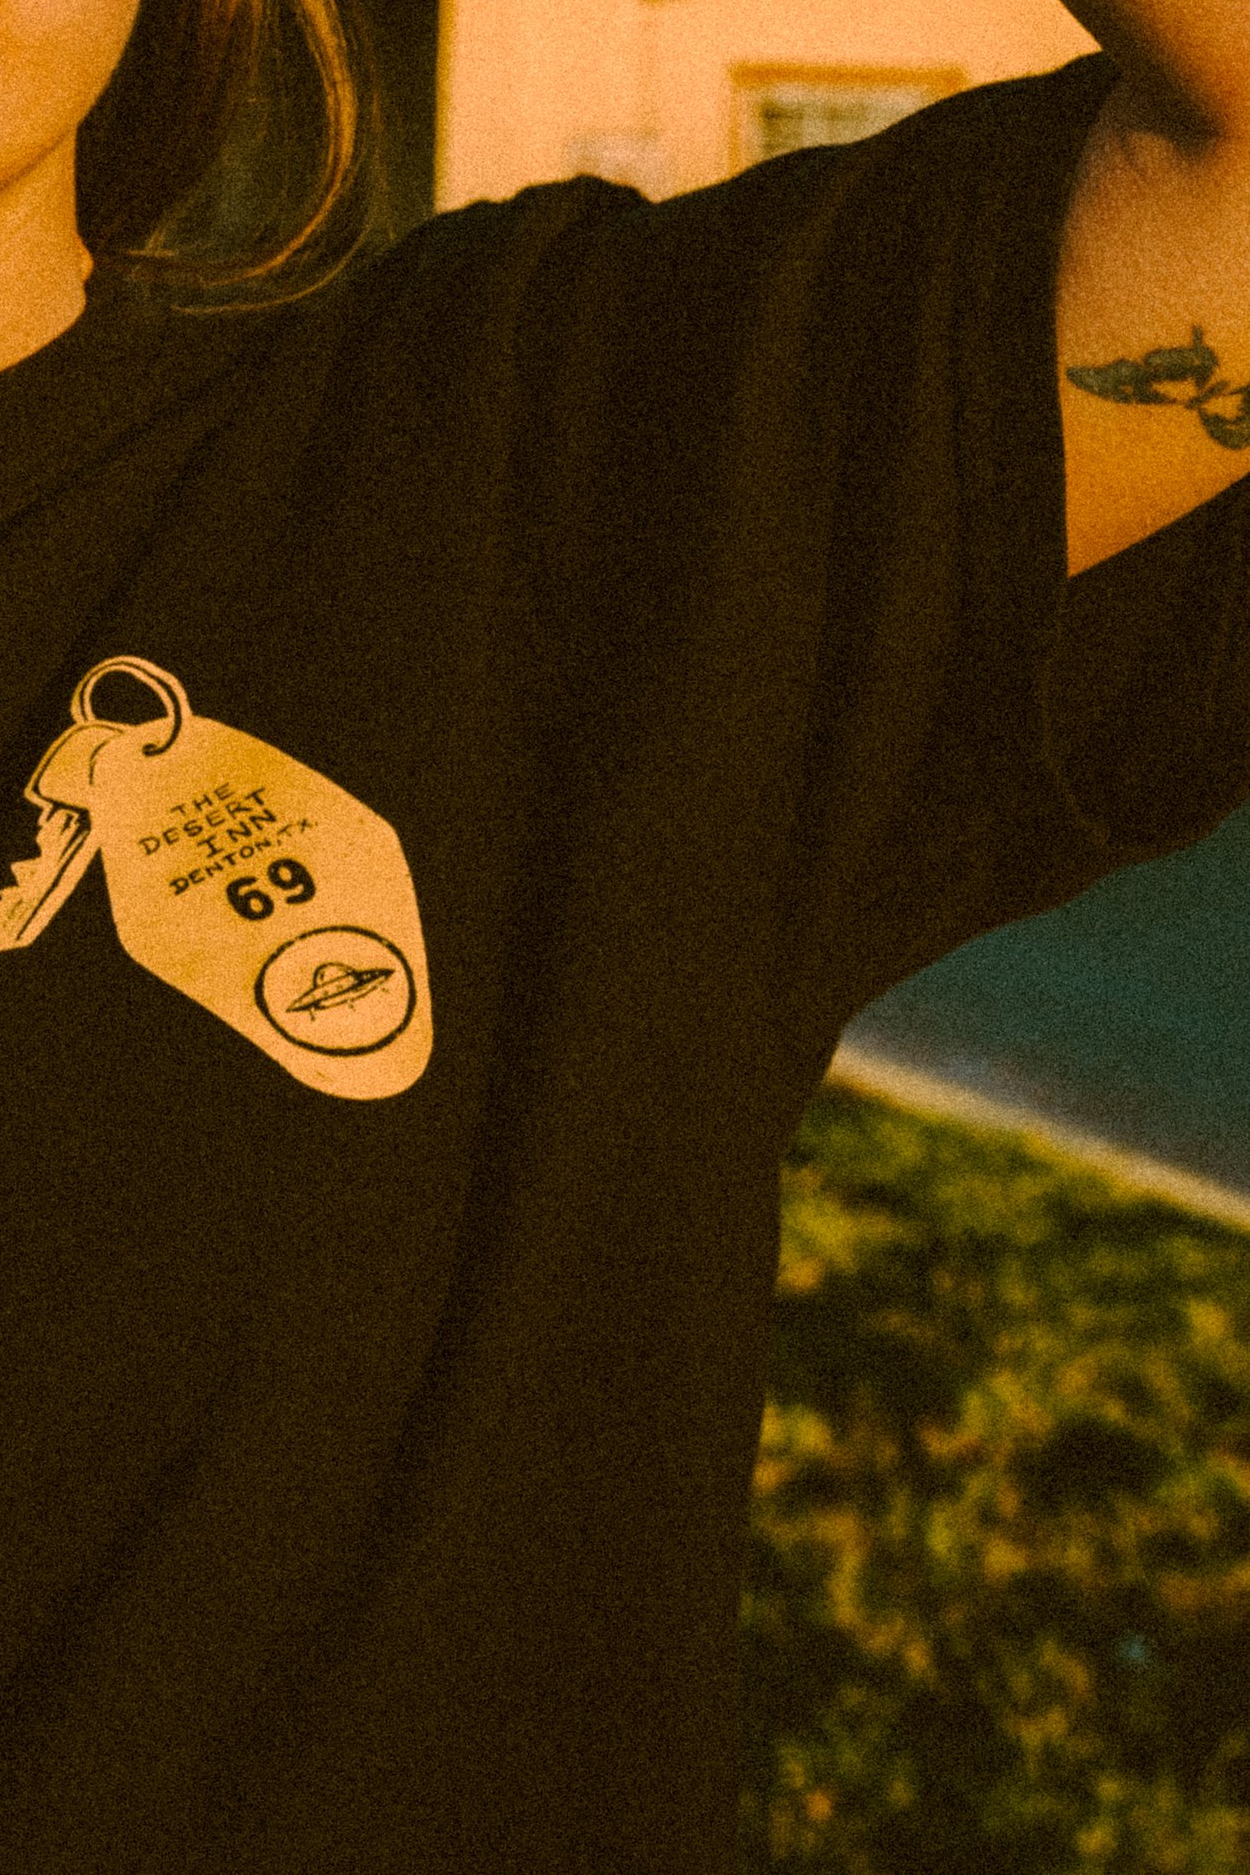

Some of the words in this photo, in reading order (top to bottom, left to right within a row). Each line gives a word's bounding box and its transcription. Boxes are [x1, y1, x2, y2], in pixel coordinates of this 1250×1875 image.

[138, 786, 267, 857] DESERT
[170, 781, 235, 817] THE
[197, 808, 277, 859] INN
[225, 857, 317, 922] 69
